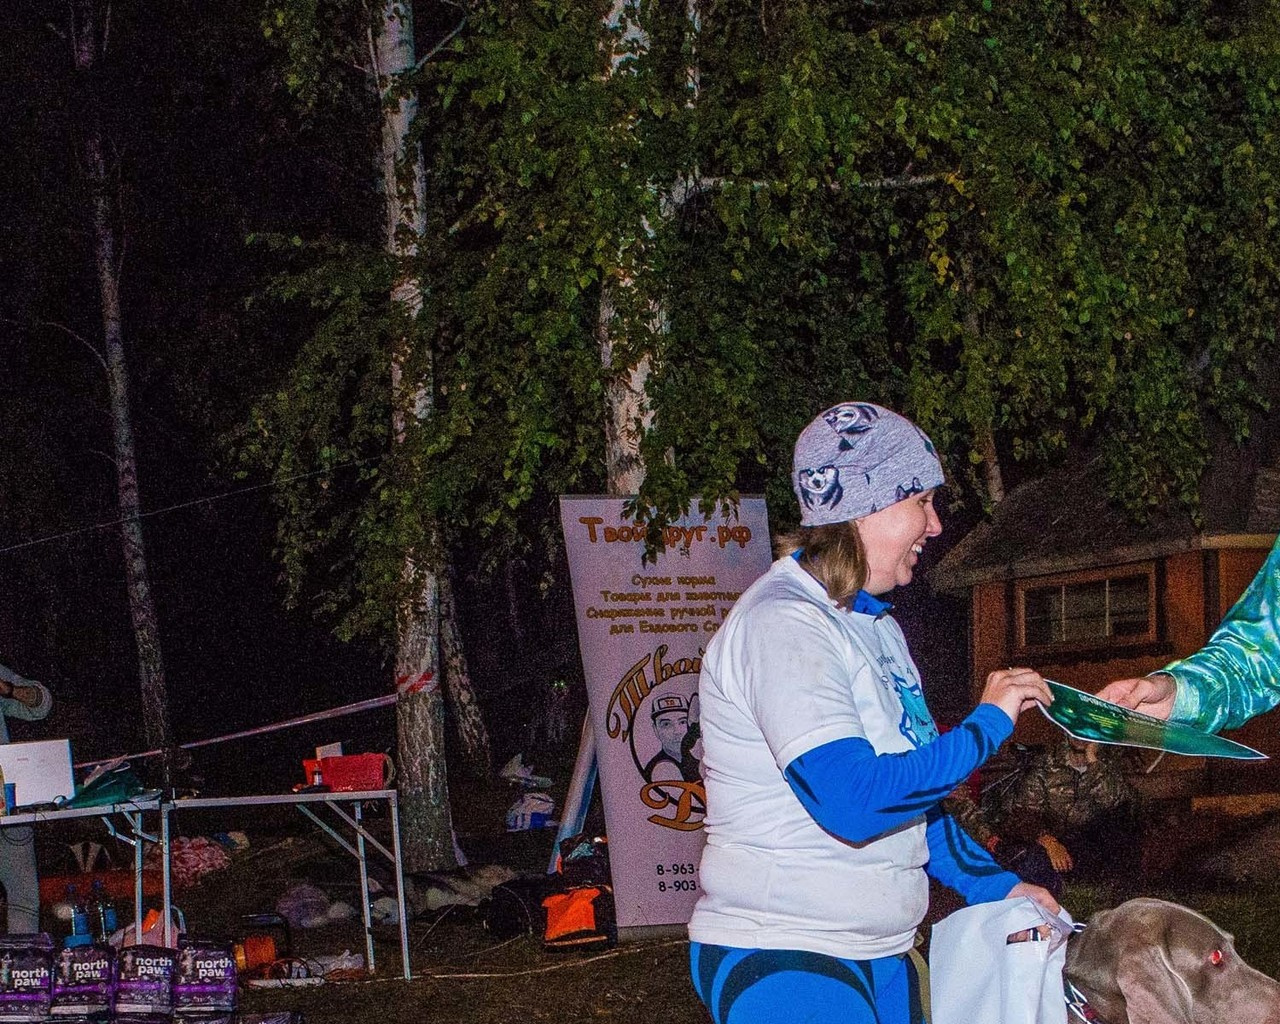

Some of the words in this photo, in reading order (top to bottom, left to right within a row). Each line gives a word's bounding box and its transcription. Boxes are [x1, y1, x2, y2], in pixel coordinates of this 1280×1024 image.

[579, 517, 752, 548] Твойруг.рф
[631, 574, 672, 588] Сухие
[677, 575, 716, 588] корма
[600, 590, 652, 604] Товары
[657, 592, 681, 602] для
[686, 591, 742, 601] животны
[586, 606, 665, 620] Снаряжение
[670, 604, 716, 619] ручной
[610, 623, 634, 635] для
[639, 620, 698, 634] Ездового
[73, 959, 109, 971] north
[136, 957, 172, 967] north
[196, 957, 232, 969] north
[11, 967, 49, 979] north
[75, 969, 101, 981] paw
[138, 964, 165, 976] paw
[198, 967, 226, 979] paw
[14, 978, 41, 988] paw
